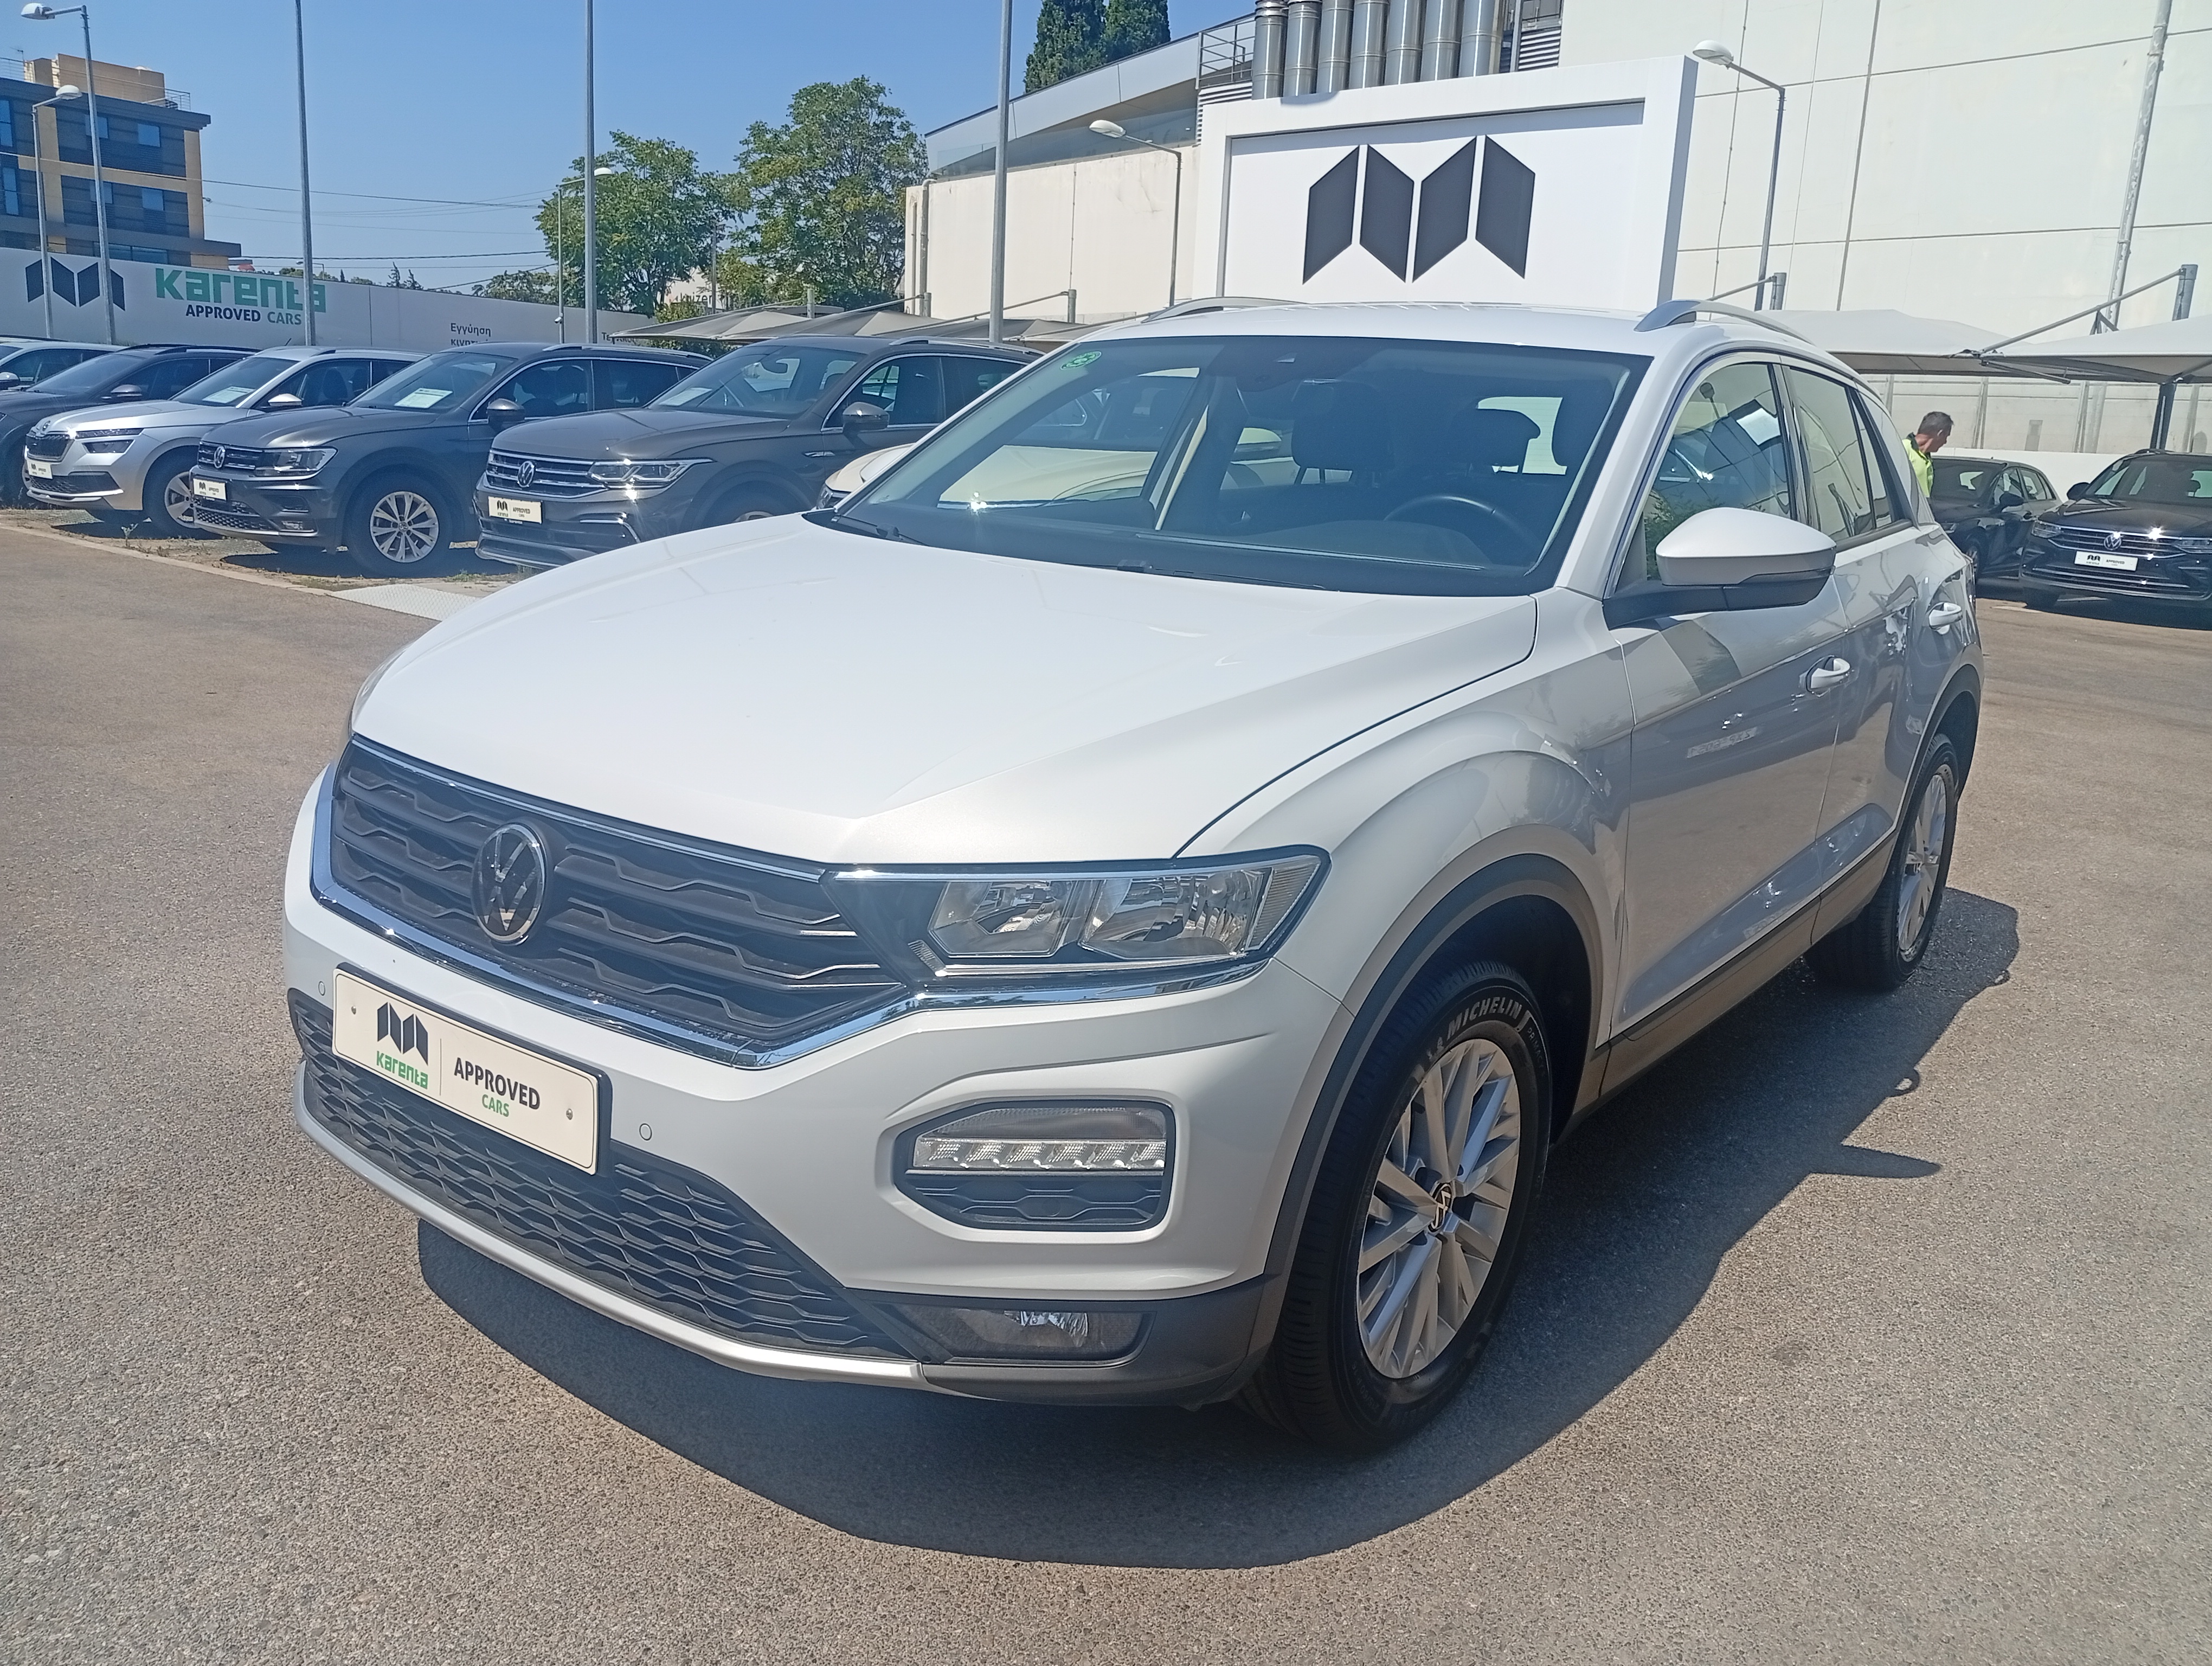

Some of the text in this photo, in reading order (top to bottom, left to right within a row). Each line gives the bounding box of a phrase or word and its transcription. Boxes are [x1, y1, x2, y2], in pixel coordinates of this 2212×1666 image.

[185, 304, 302, 325] APPROVED CARS
[451, 323, 491, 337] Εγγύηση
[1446, 996, 1522, 1041] MICHELIN
[454, 1057, 541, 1110] APPROVED
[481, 1093, 510, 1117] CARS
